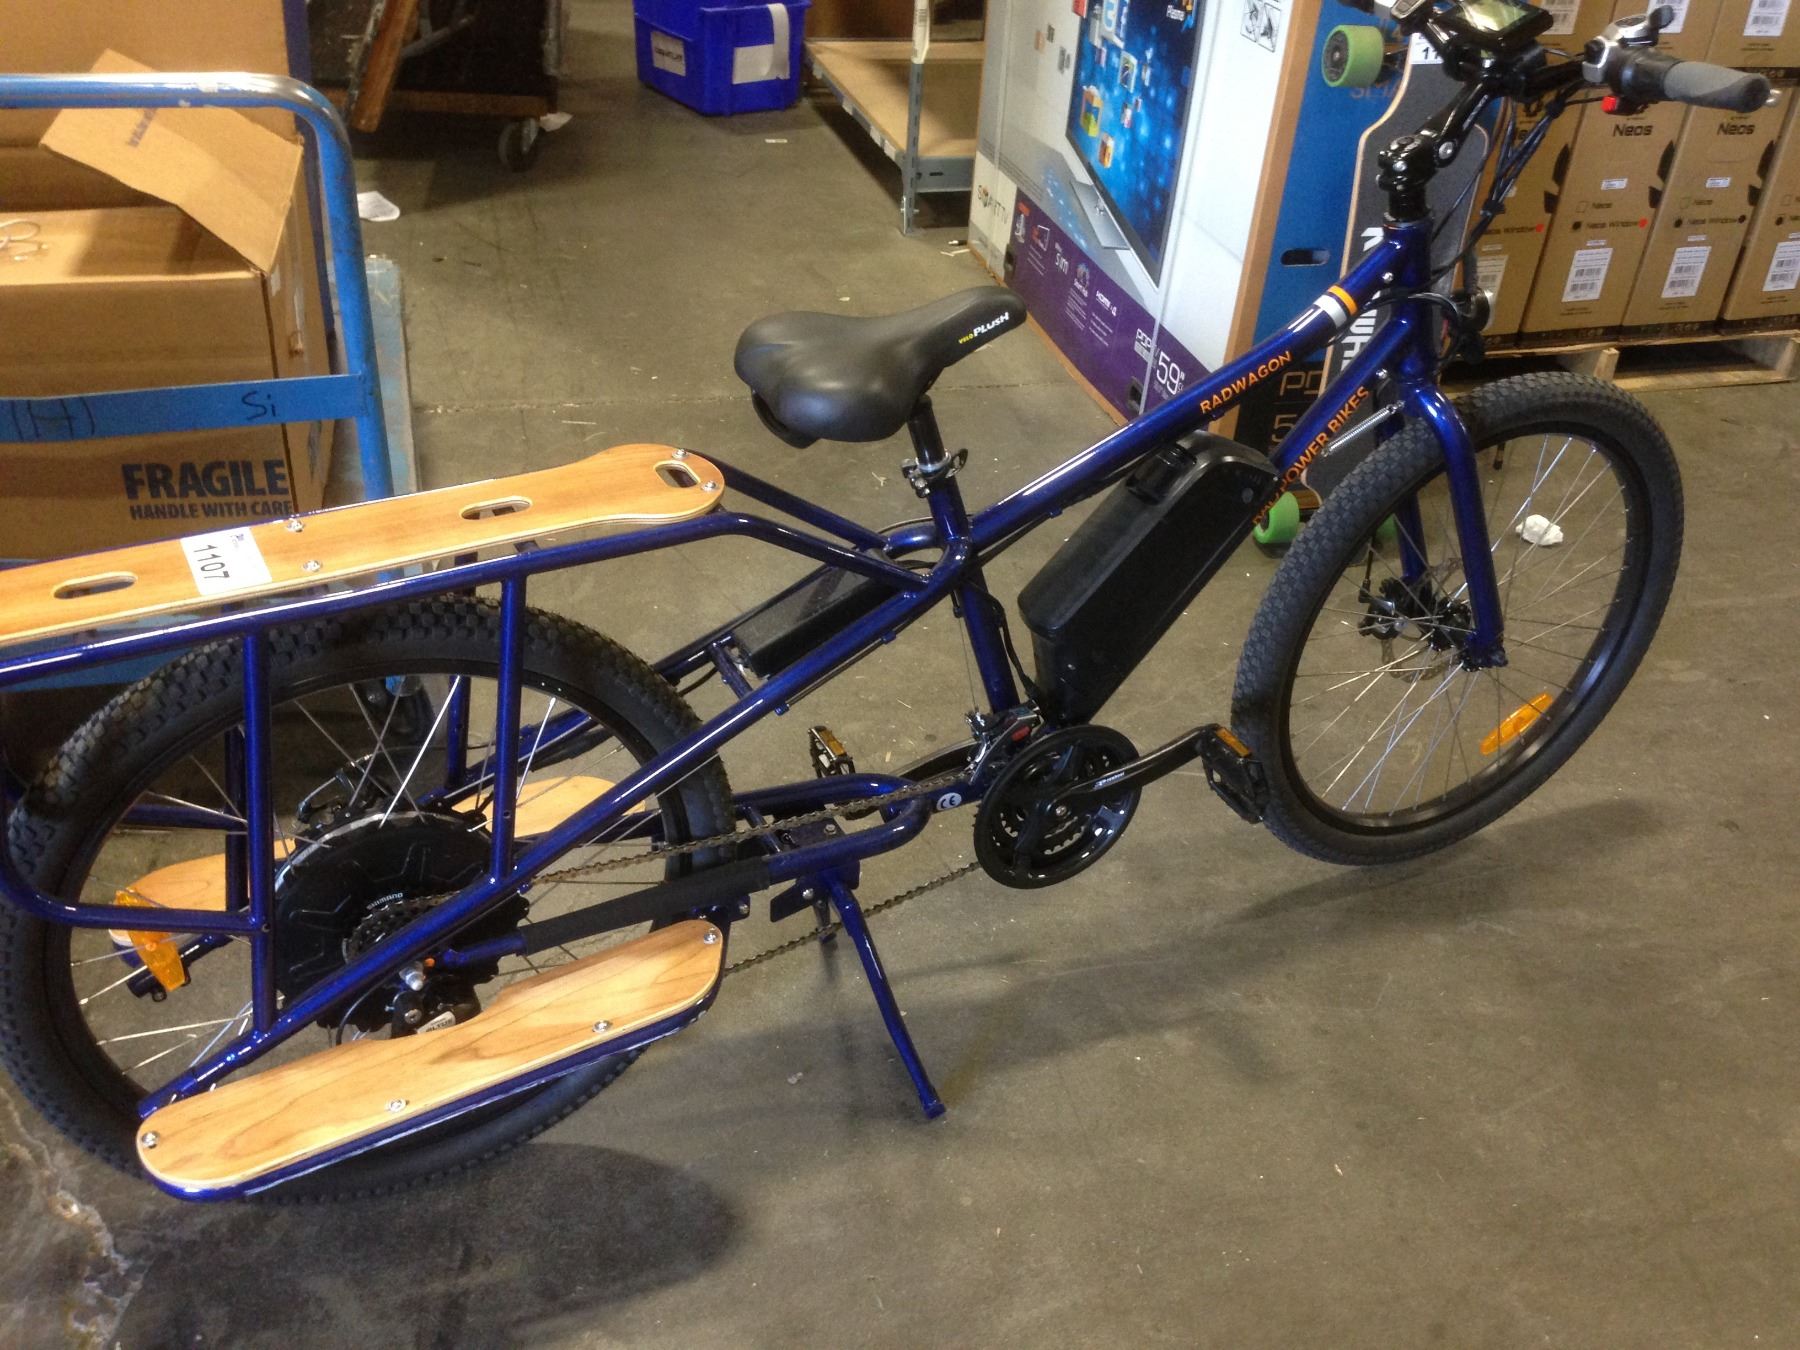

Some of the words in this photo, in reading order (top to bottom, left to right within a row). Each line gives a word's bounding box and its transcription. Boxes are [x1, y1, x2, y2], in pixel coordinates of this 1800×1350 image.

[1612, 124, 1653, 138] Neos
[1717, 122, 1756, 136] Neos
[973, 311, 1009, 337] PLUSH
[1200, 350, 1293, 415] RADWAGON
[1327, 385, 1371, 434] BIKES
[121, 459, 290, 500] FRAGILE
[130, 502, 199, 520] HANDLE
[202, 501, 247, 517] WITH
[250, 500, 293, 517] CARE
[193, 544, 230, 581] 1107
